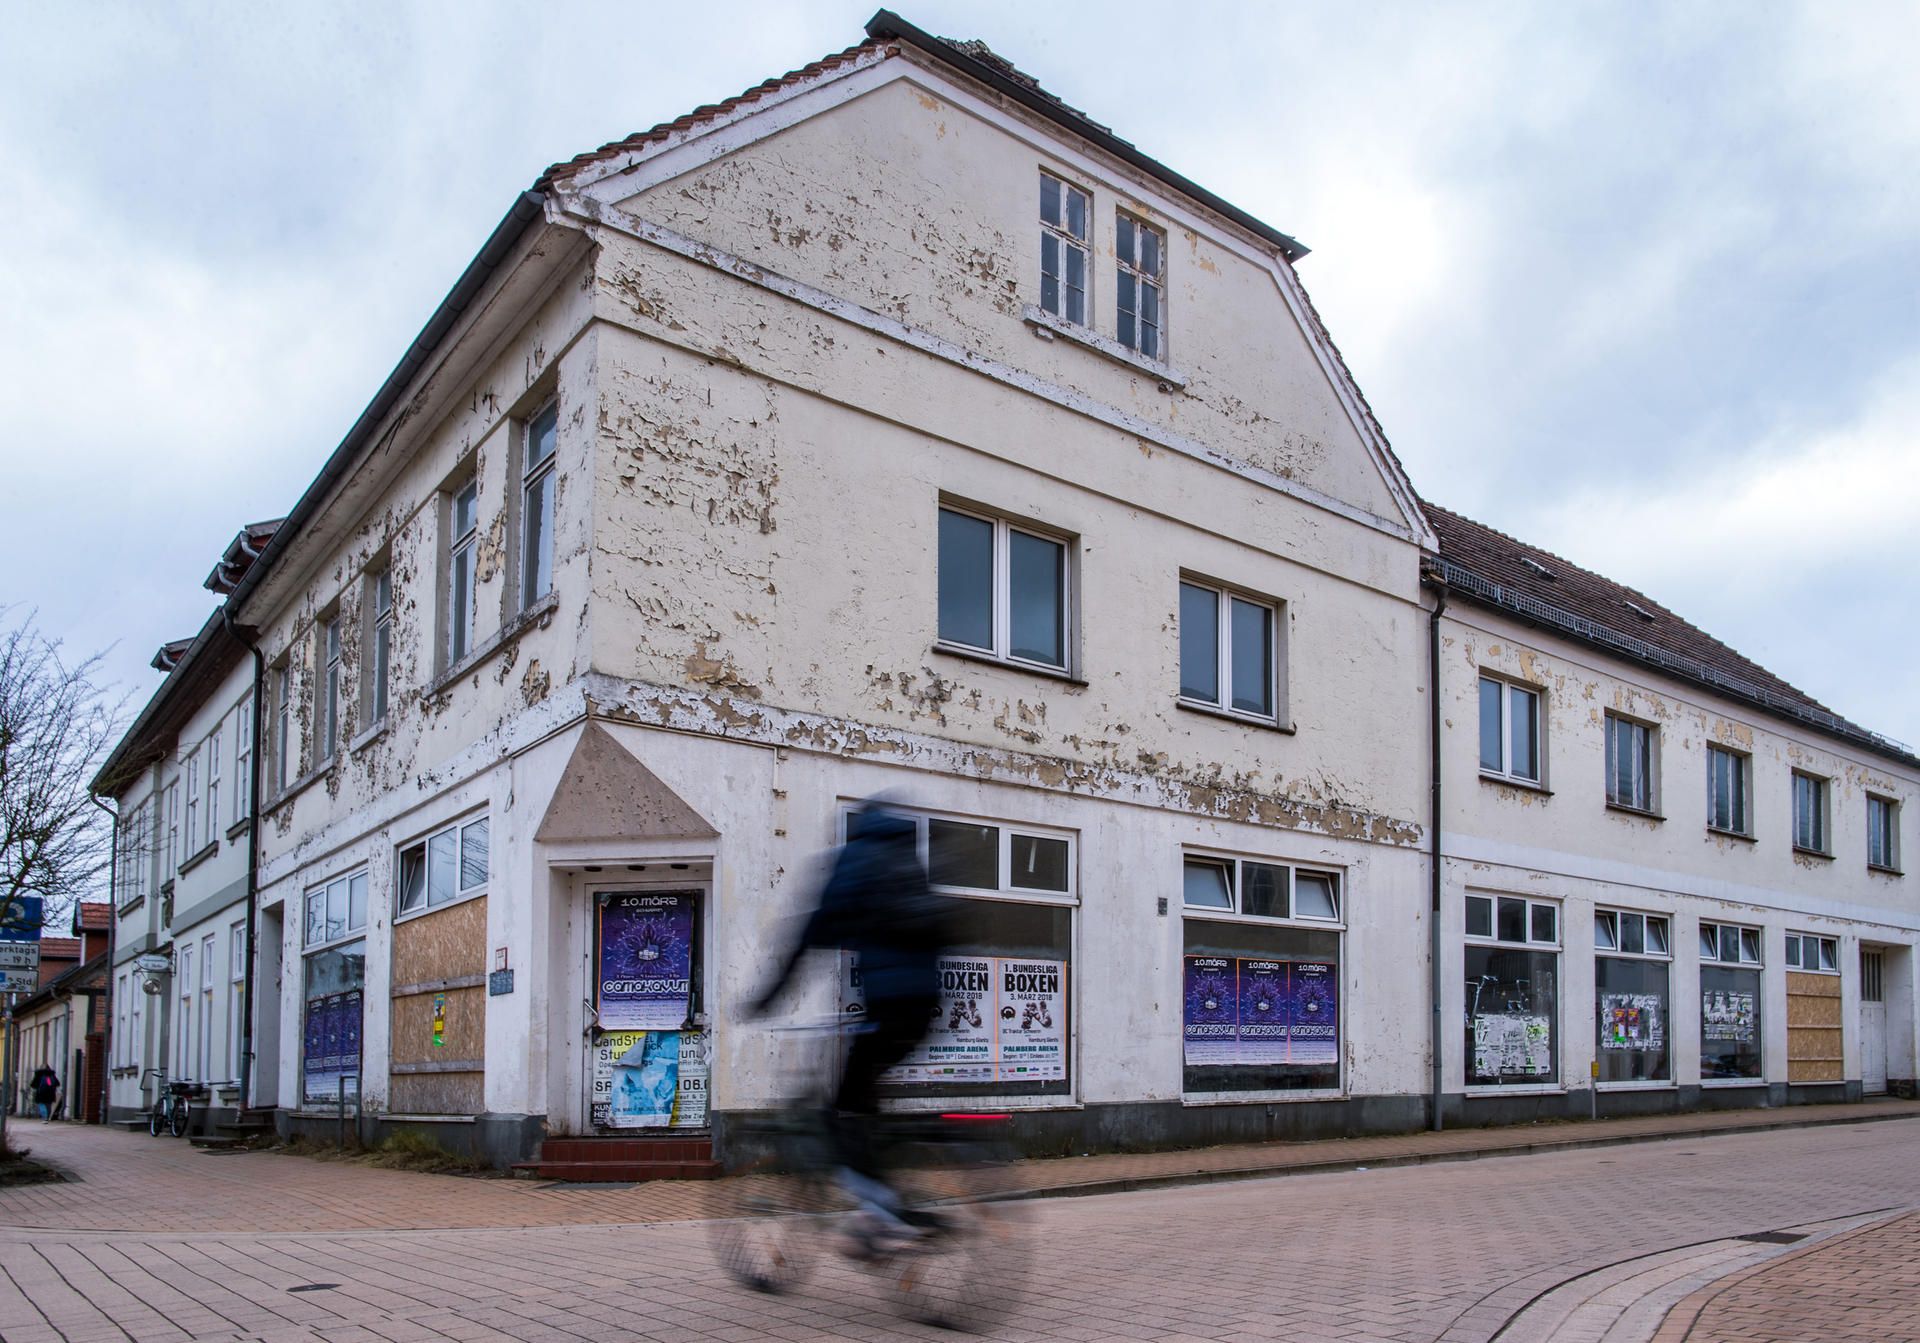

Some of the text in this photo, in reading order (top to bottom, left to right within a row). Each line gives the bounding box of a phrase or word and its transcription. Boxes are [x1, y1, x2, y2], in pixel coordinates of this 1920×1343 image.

[940, 961, 988, 971] BUNDESLIGA
[1013, 964, 1058, 974] BUNDESLIGA
[936, 971, 988, 991] BOXEN
[1005, 973, 1058, 993] BOXEN
[683, 1080, 707, 1091] 06.
